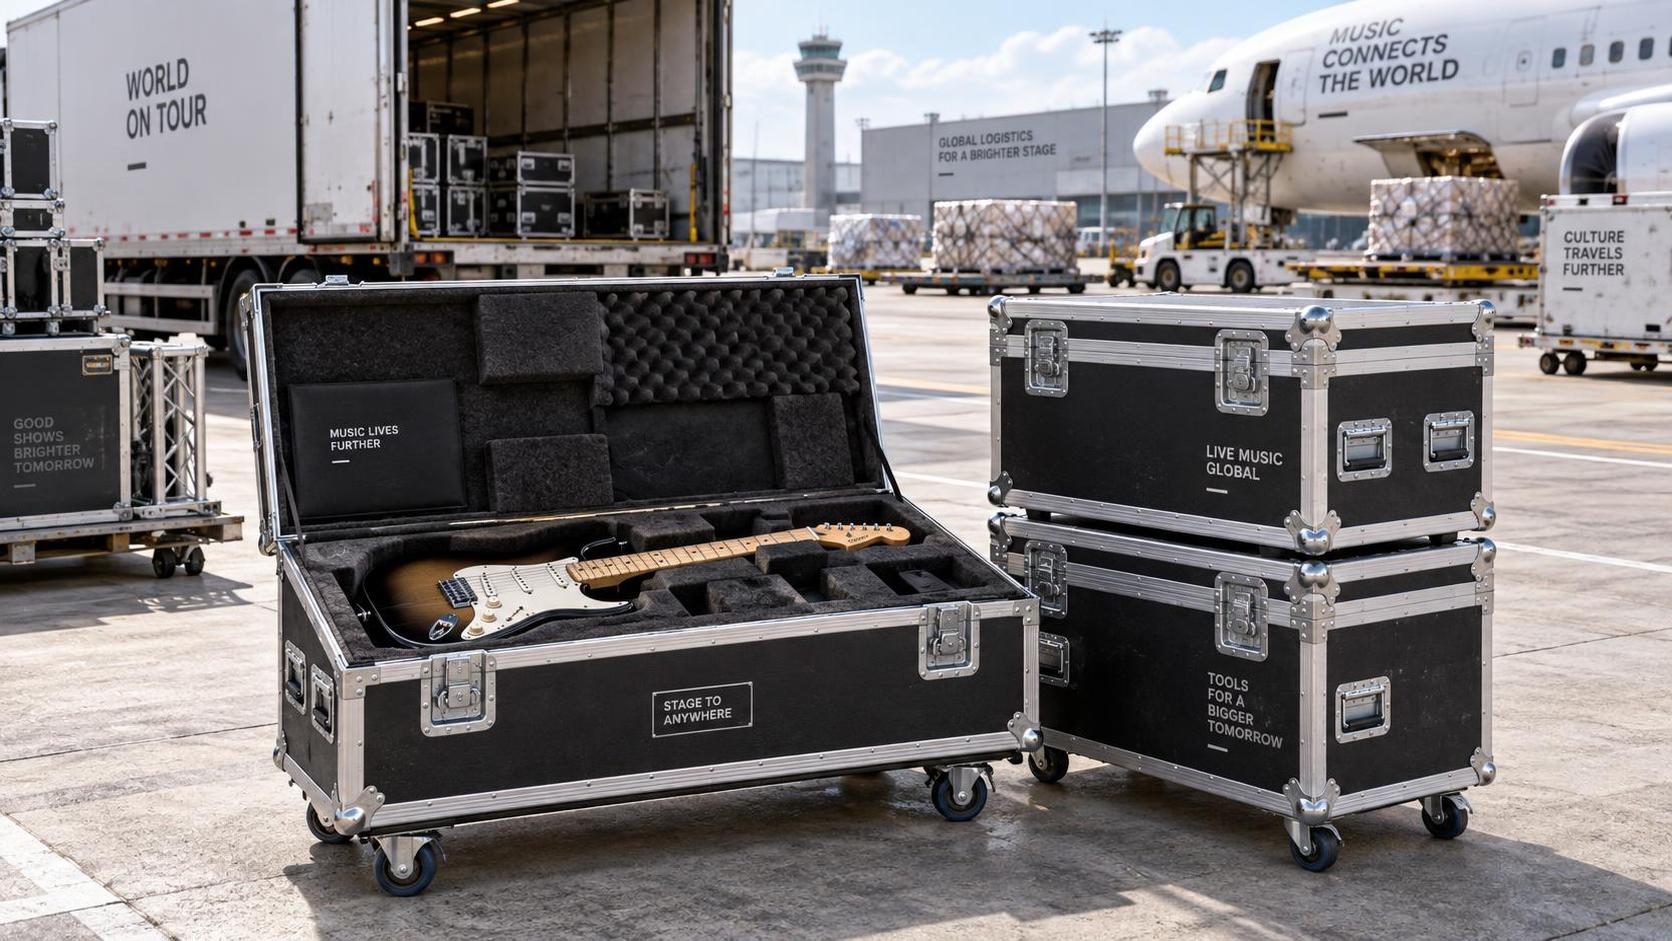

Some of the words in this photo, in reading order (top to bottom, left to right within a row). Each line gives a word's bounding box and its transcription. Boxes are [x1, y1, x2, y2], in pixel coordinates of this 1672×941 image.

[1329, 18, 1403, 45] MUSIC
[1323, 34, 1448, 69] CONNECTS
[127, 58, 189, 100] WORLD
[1320, 71, 1361, 93] THE
[1370, 59, 1459, 88] WORLD
[127, 106, 150, 139] ON
[157, 94, 206, 133] TOUR
[939, 135, 977, 148] GLOBAL
[981, 130, 1033, 145] LOGISTICS
[939, 151, 957, 162] FOR
[960, 151, 968, 160] A
[970, 146, 1020, 160] BRIGHTER
[1023, 144, 1056, 157] STAGE
[1564, 231, 1624, 243] CULTURE
[1564, 247, 1622, 259] TRAVELS
[1563, 263, 1624, 276] FURTHER
[14, 417, 54, 429] GOOD
[330, 428, 365, 438] MUSIC
[369, 426, 398, 435] LIVES
[14, 431, 64, 444] SHOWS
[331, 439, 380, 450] FURTHER
[15, 445, 80, 459] BRIGHTER
[1207, 445, 1234, 460] LIVE
[1239, 449, 1282, 465] MUSIC
[14, 458, 94, 473] TOMORROW
[1207, 462, 1260, 480] GLOBAL
[1208, 672, 1248, 691] TOOLS
[664, 698, 702, 711] STAGE
[705, 696, 721, 706] TO
[1209, 688, 1232, 704] FOR
[1235, 695, 1245, 707] A
[664, 708, 731, 725] ANYWHERE
[1208, 704, 1253, 726] BIGGER
[1208, 720, 1282, 748] TOMORROW
